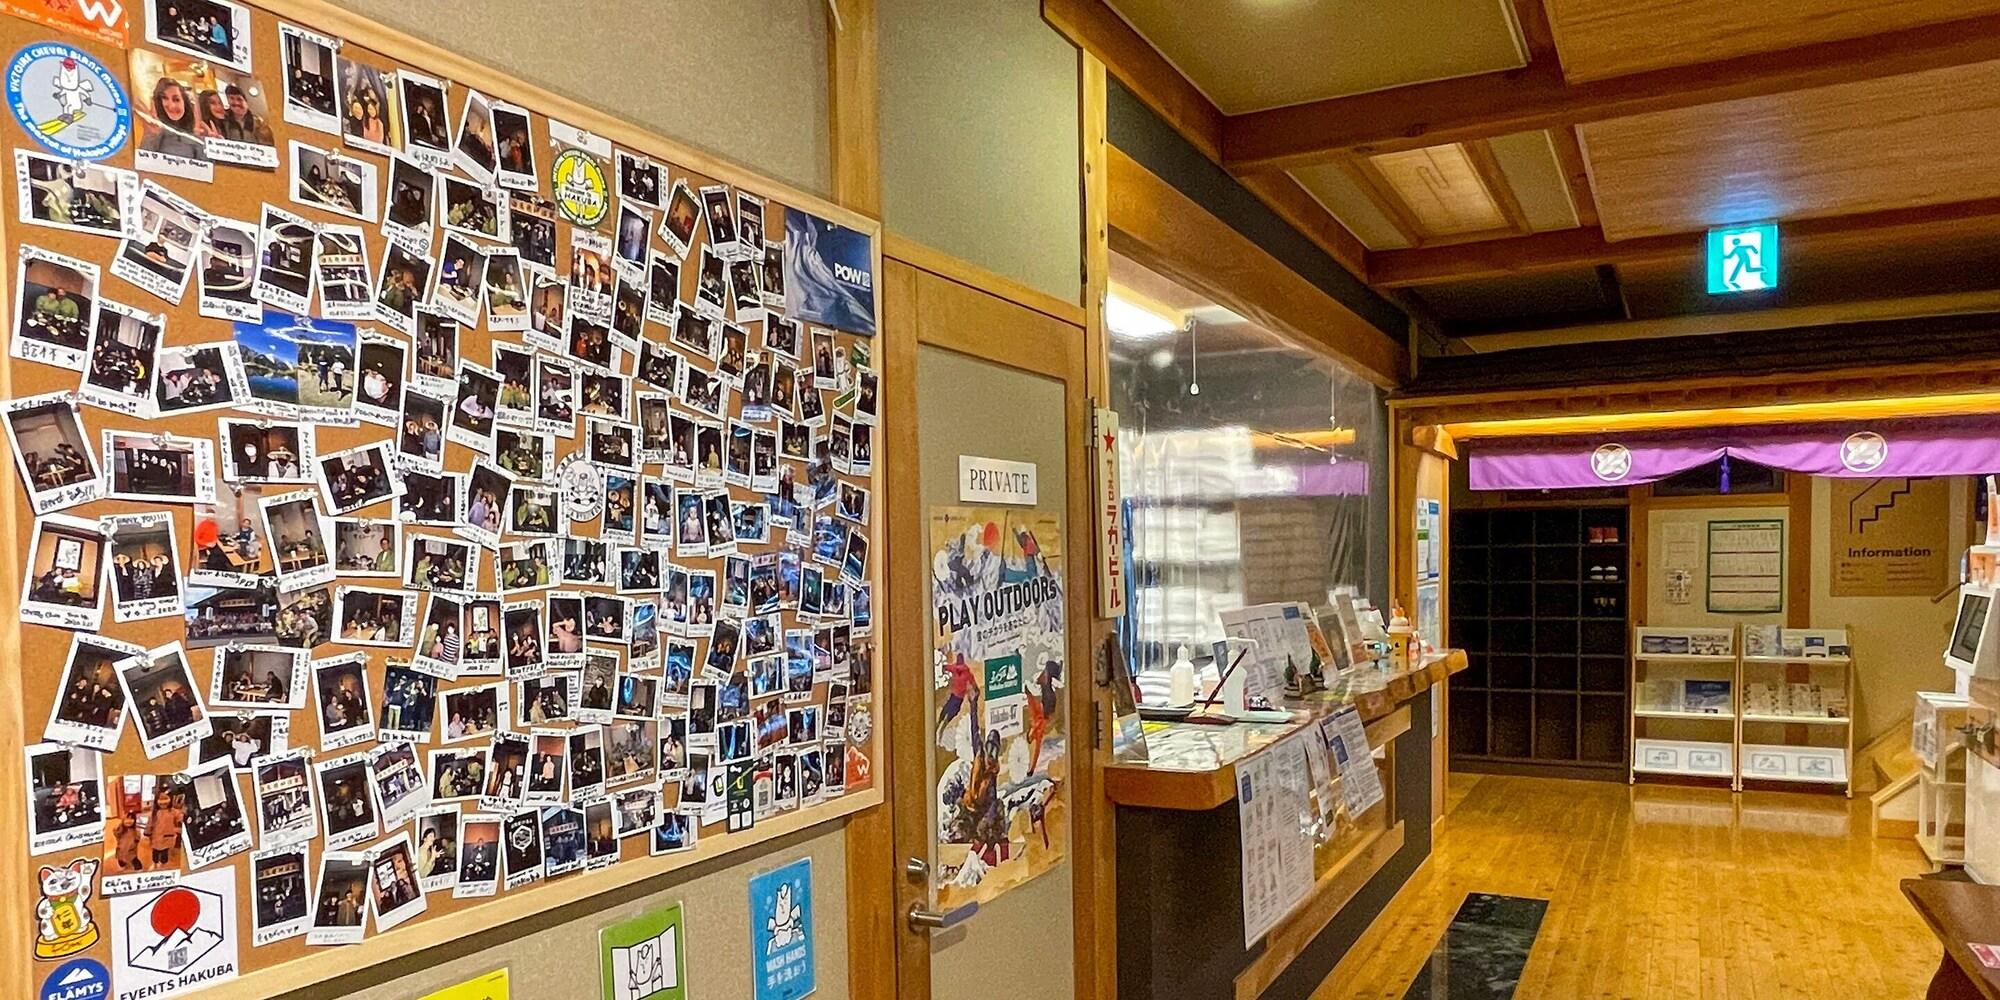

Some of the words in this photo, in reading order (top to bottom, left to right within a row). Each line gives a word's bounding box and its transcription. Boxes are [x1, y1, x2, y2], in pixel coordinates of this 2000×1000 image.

[564, 192, 597, 206] HAKUBA
[834, 262, 862, 285] POW
[969, 468, 1030, 494] PRIVATE
[1106, 504, 1121, 609] ラガービール
[1848, 547, 1931, 558] Information
[938, 595, 980, 636] PLAY
[983, 576, 1057, 621] OUTDOORS
[120, 979, 175, 1000] EVENTS
[178, 967, 234, 988] HAKUBA
